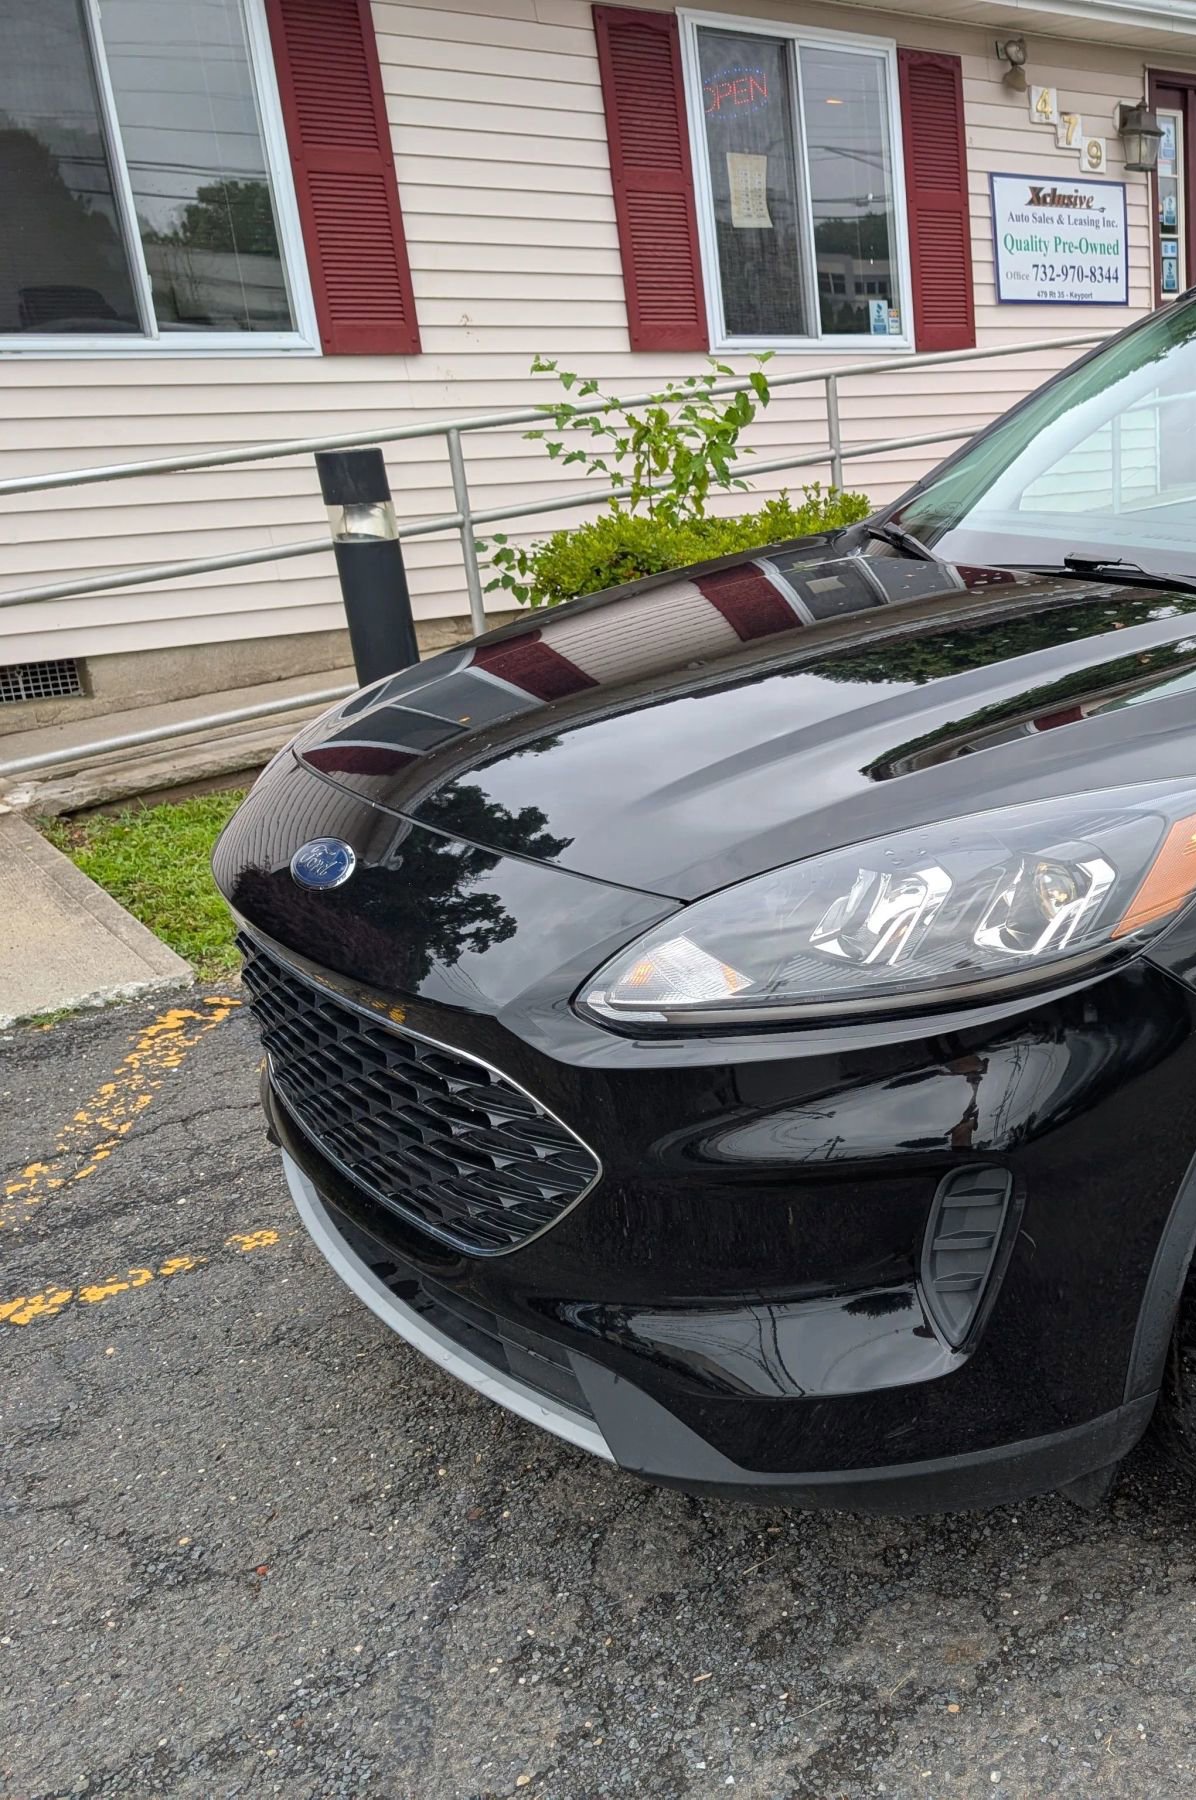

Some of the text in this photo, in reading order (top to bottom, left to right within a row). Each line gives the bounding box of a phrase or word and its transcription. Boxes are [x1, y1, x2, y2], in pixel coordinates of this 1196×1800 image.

[1025, 186, 1095, 209] Xclusive
[1008, 211, 1118, 230] Auto Sales & Leasing Inc.
[1003, 233, 1120, 257] Quality Pre-Owned
[1005, 264, 1119, 284] Office 732-970-8344
[1037, 290, 1048, 299] 479
[1049, 291, 1056, 299] Rt
[1057, 291, 1065, 299] 35
[1070, 291, 1093, 301] Keyport
[299, 844, 339, 876] Ford
